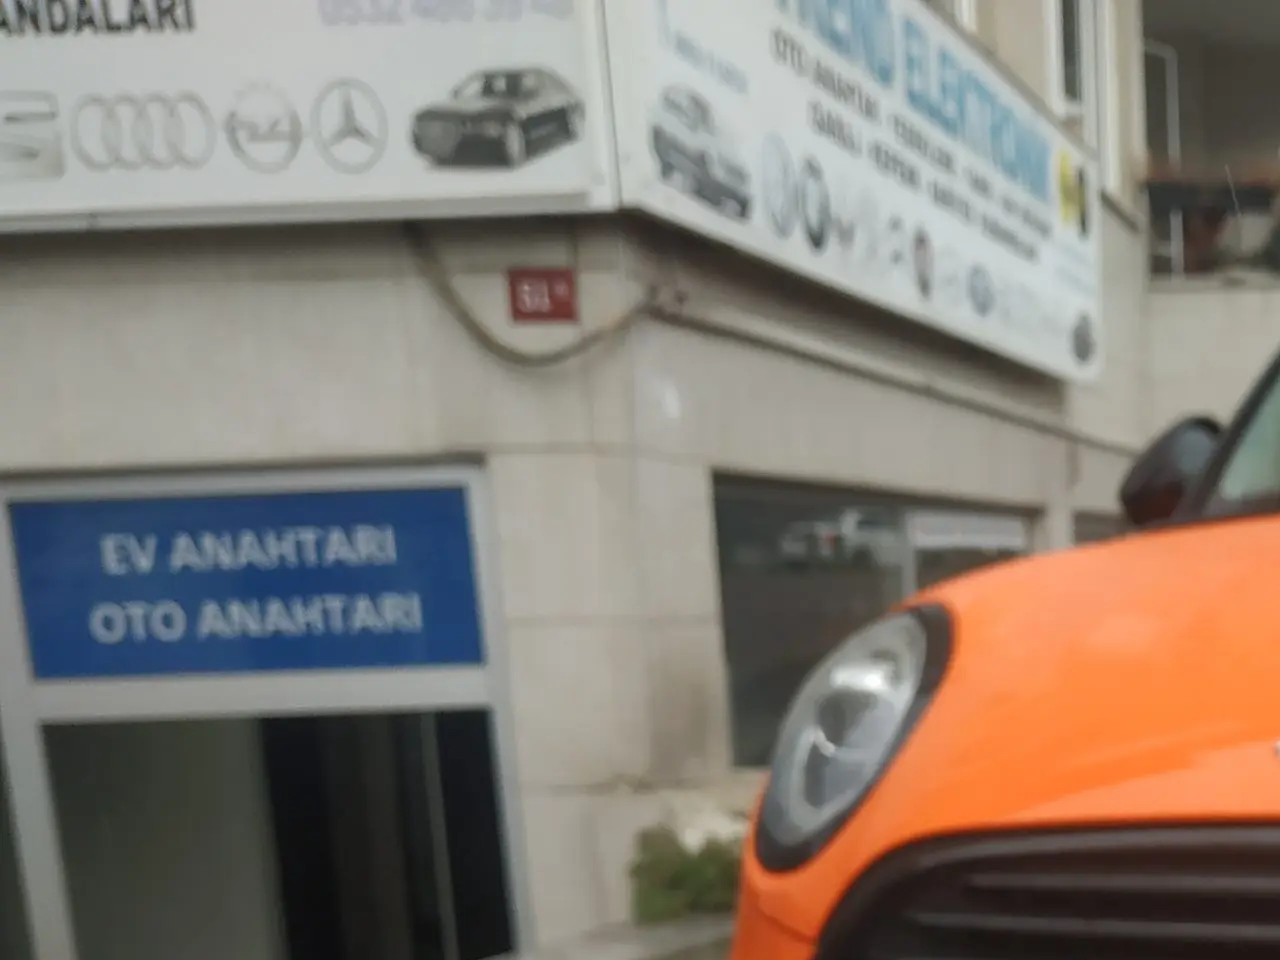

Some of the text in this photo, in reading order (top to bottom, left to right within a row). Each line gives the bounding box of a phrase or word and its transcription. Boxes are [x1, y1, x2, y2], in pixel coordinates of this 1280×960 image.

[101, 523, 397, 575] EV ANAHTARI
[89, 591, 423, 645] OTO ANAHTARI
